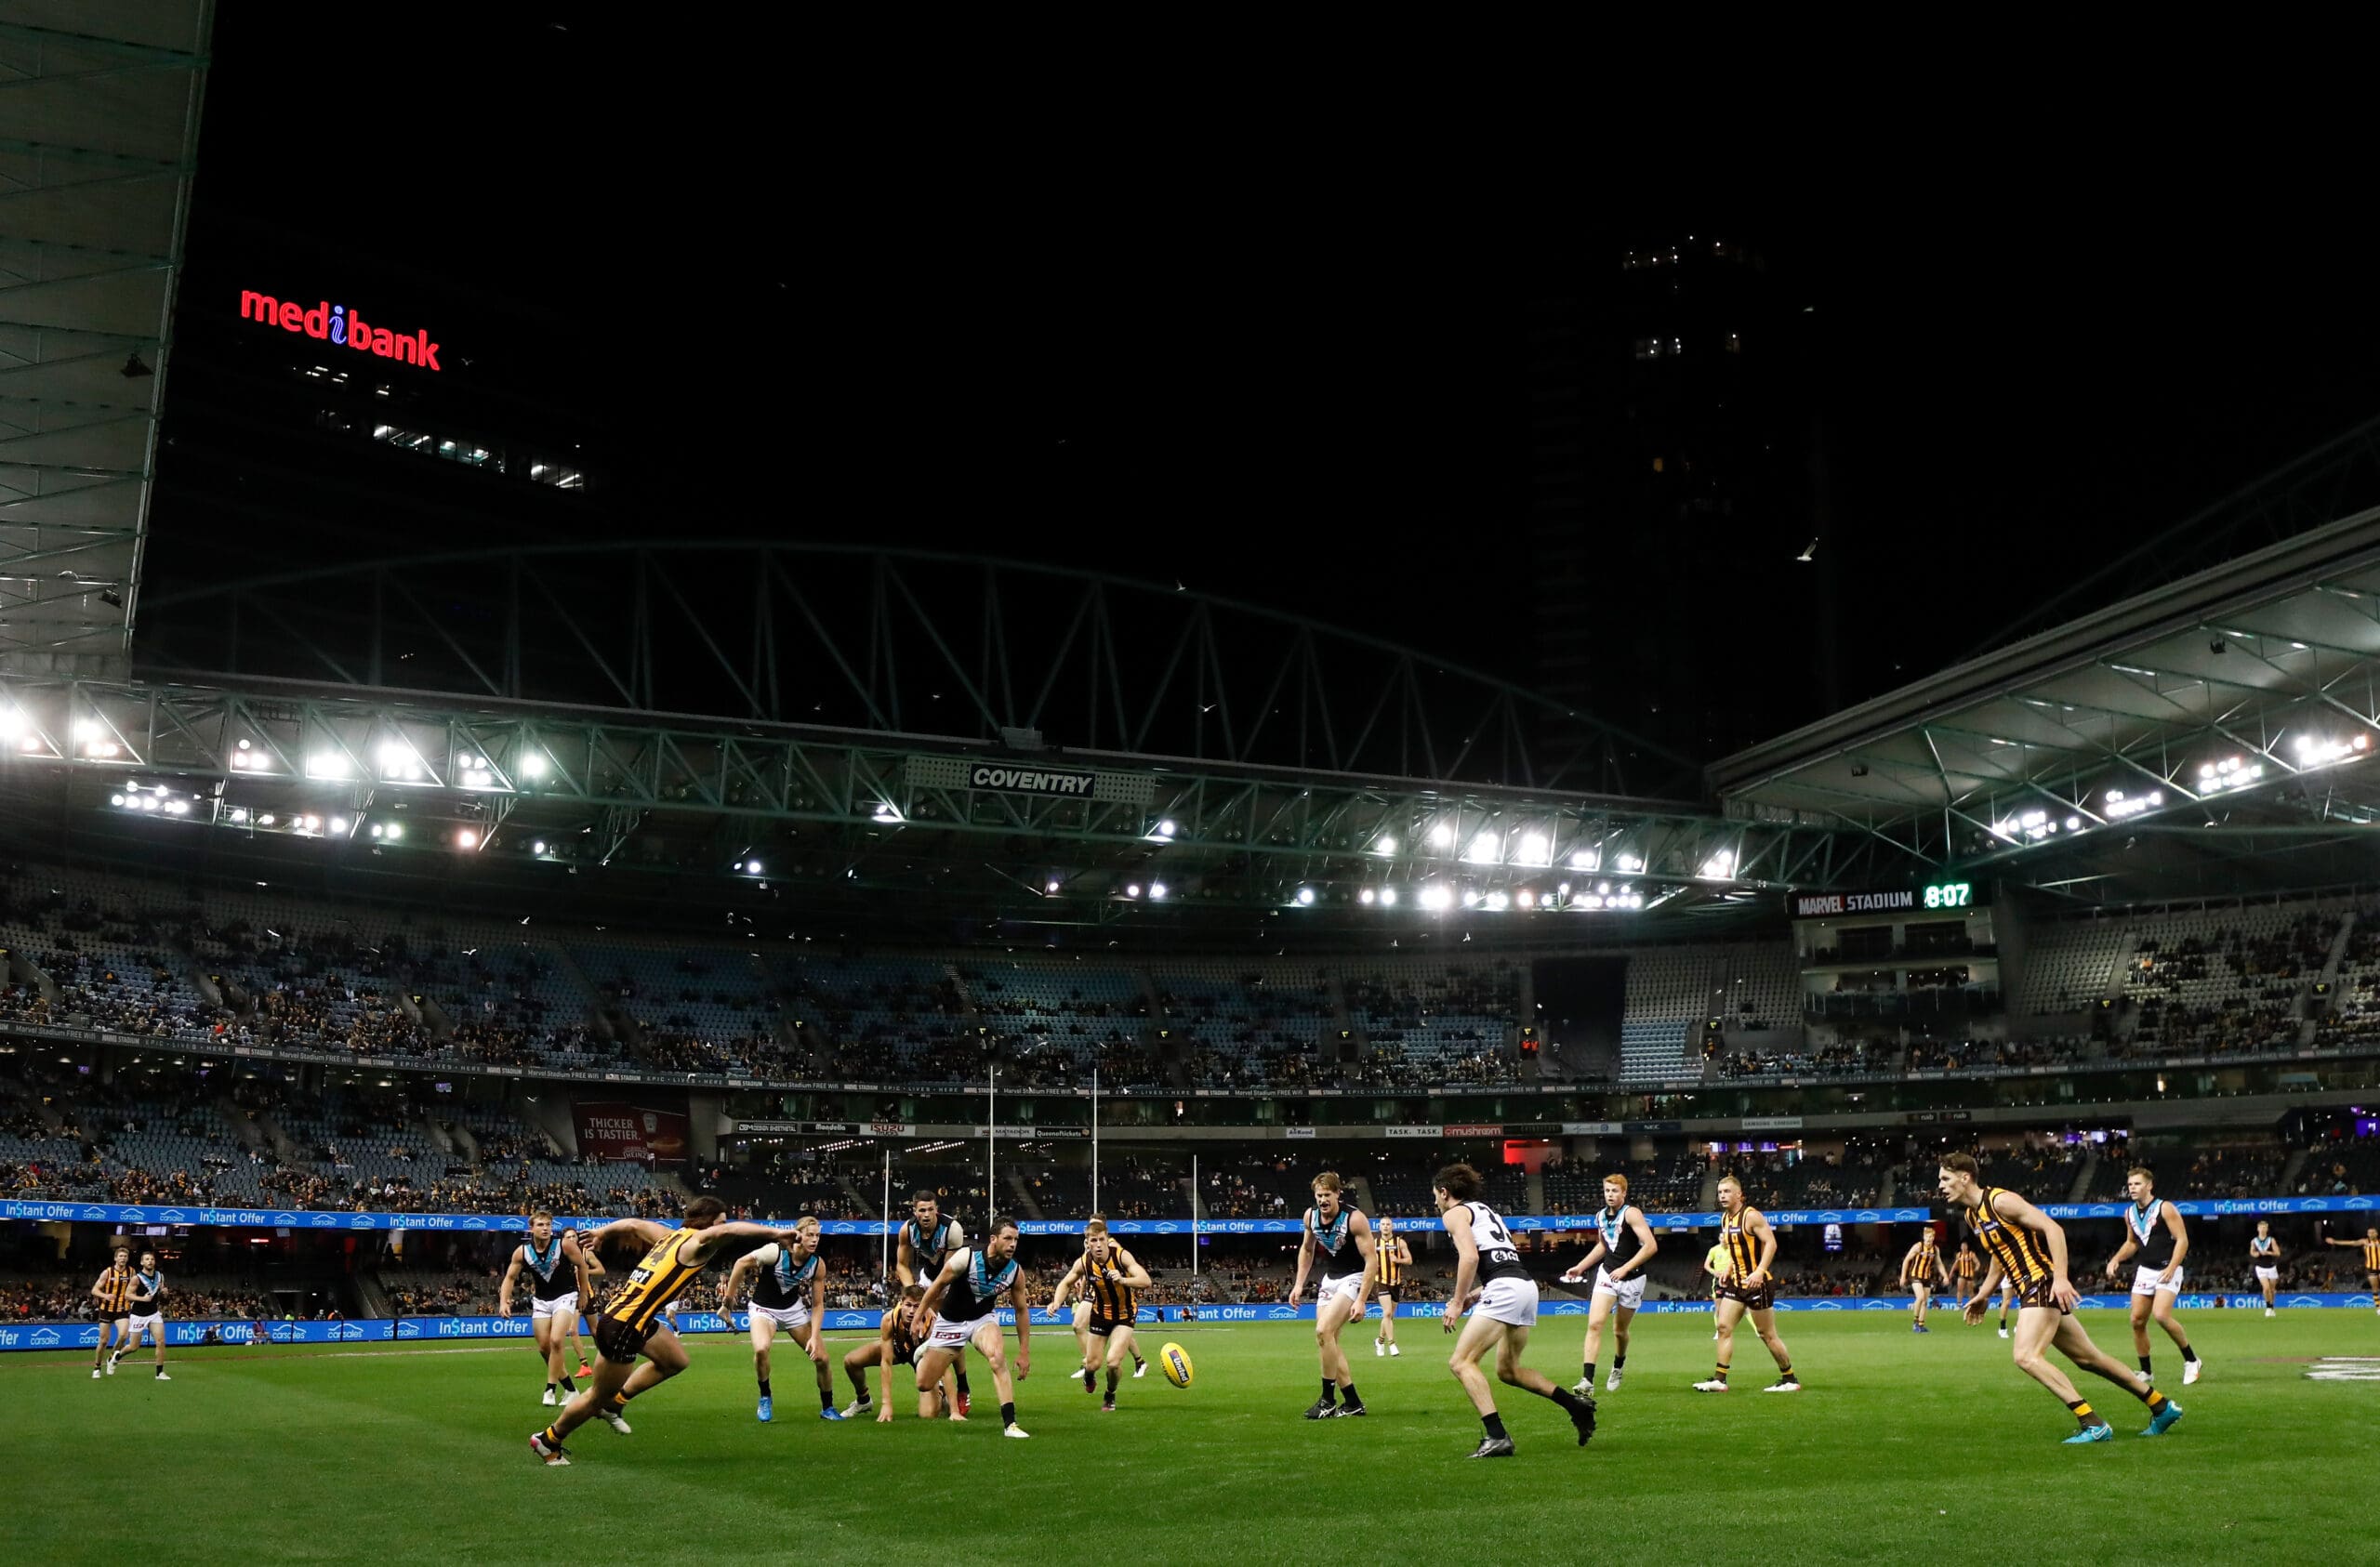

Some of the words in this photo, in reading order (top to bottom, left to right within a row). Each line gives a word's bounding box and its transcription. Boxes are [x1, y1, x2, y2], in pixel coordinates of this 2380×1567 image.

[241, 290, 441, 371] medibank
[973, 768, 1093, 794] COVENTRY
[1798, 895, 1844, 915] MARVEL
[1846, 890, 1913, 912] STADIUM
[1924, 883, 1970, 908] 8:07
[588, 1117, 634, 1129] THICKER
[584, 1128, 595, 1139] IS
[597, 1129, 641, 1141] TASTIER.
[1452, 1126, 1501, 1136] mushroom
[46, 1205, 74, 1218] Offer
[2050, 1206, 2079, 1217] Offer
[2258, 1201, 2289, 1212] Offer
[239, 1212, 266, 1224] Offer
[428, 1217, 454, 1228] Offer
[1781, 1212, 1807, 1223] Offer
[1049, 1223, 1074, 1231] Offer
[1229, 1222, 1254, 1231] Offer
[1410, 1219, 1435, 1230] Offer
[1031, 1314, 1060, 1323] carsales
[1223, 1307, 1256, 1319] Offer
[493, 1320, 527, 1334] Offer
[836, 1317, 866, 1326] carsales
[225, 1325, 253, 1339] Offe
[30, 1336, 60, 1345] carsales
[1173, 1357, 1189, 1382] United
